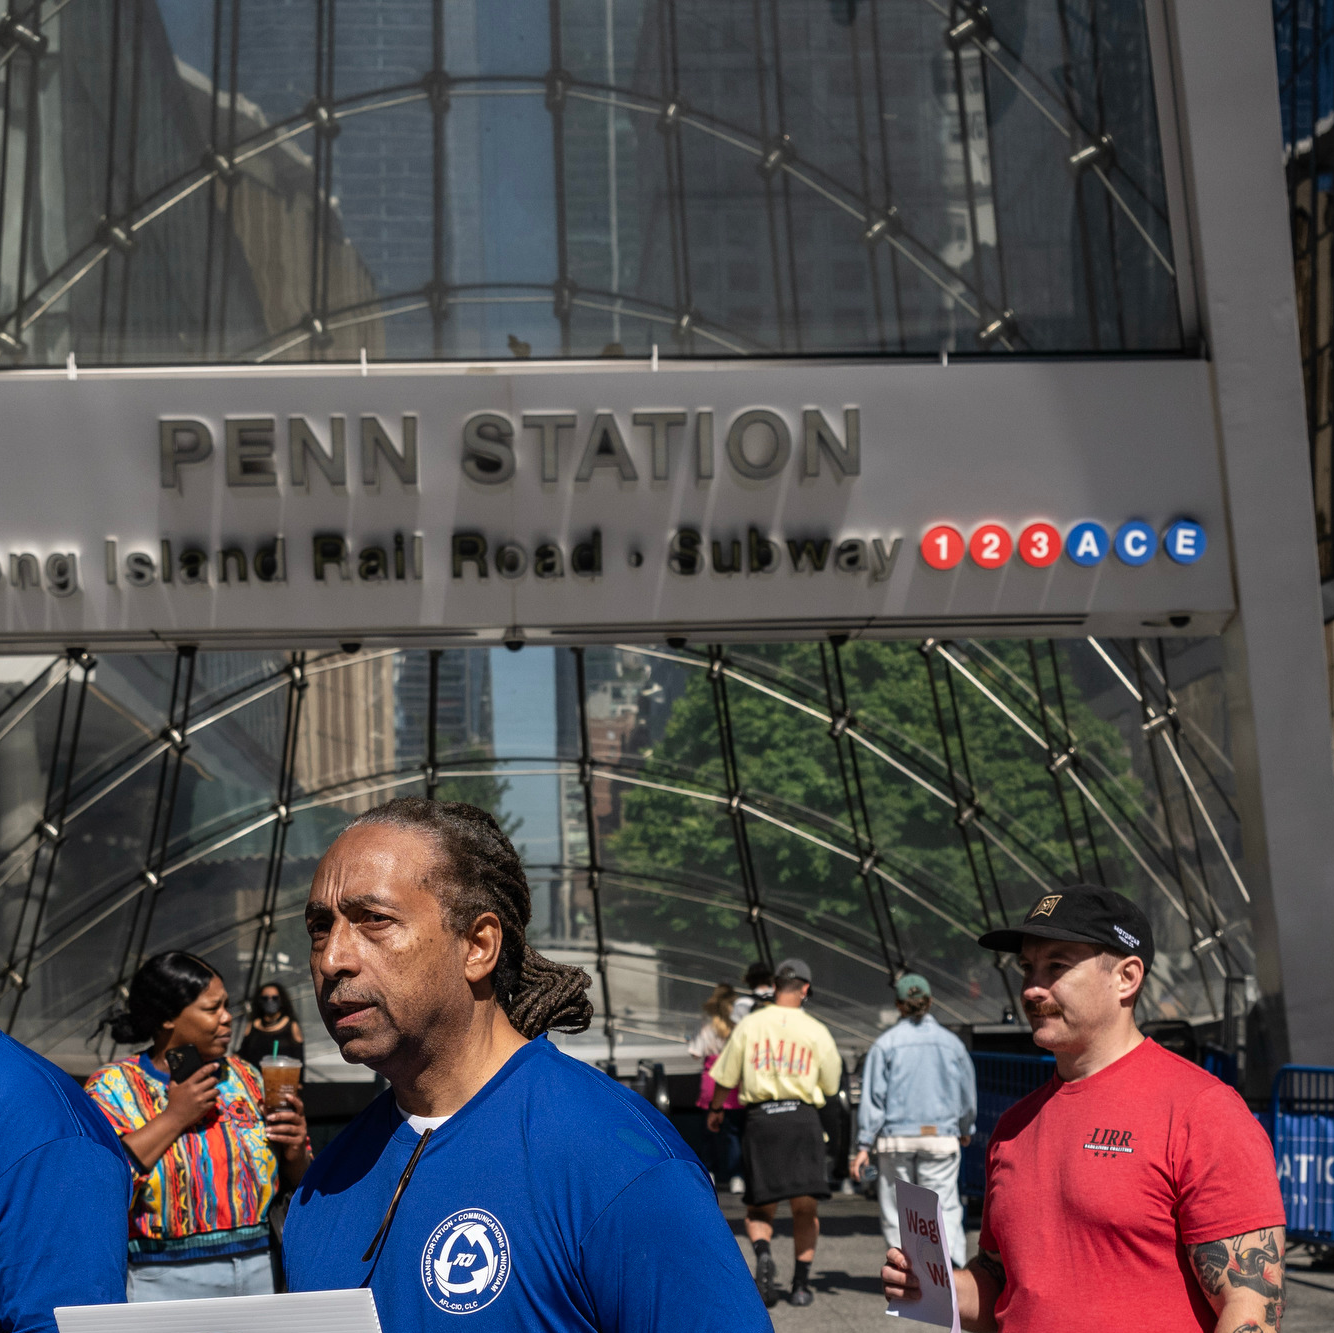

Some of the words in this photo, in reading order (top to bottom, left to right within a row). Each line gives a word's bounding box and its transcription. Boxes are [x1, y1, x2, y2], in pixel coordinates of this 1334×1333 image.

[158, 413, 417, 490] PENN
[461, 407, 861, 487] STATION
[105, 534, 286, 588] Island
[313, 531, 424, 585] Rail
[451, 531, 603, 583] Road
[669, 525, 905, 581] Subway
[934, 534, 949, 560] 1
[981, 532, 1001, 559] 2
[1029, 530, 1050, 558] 3
[1076, 531, 1102, 558] A
[1124, 530, 1148, 558] C
[1175, 528, 1197, 556] E
[424, 1219, 454, 1287] TRANSPORTATION
[457, 1212, 505, 1249] COMMUNICATIONS
[905, 1207, 940, 1245] Wag
[452, 1252, 478, 1268] TCU
[464, 1300, 478, 1310] CLC
